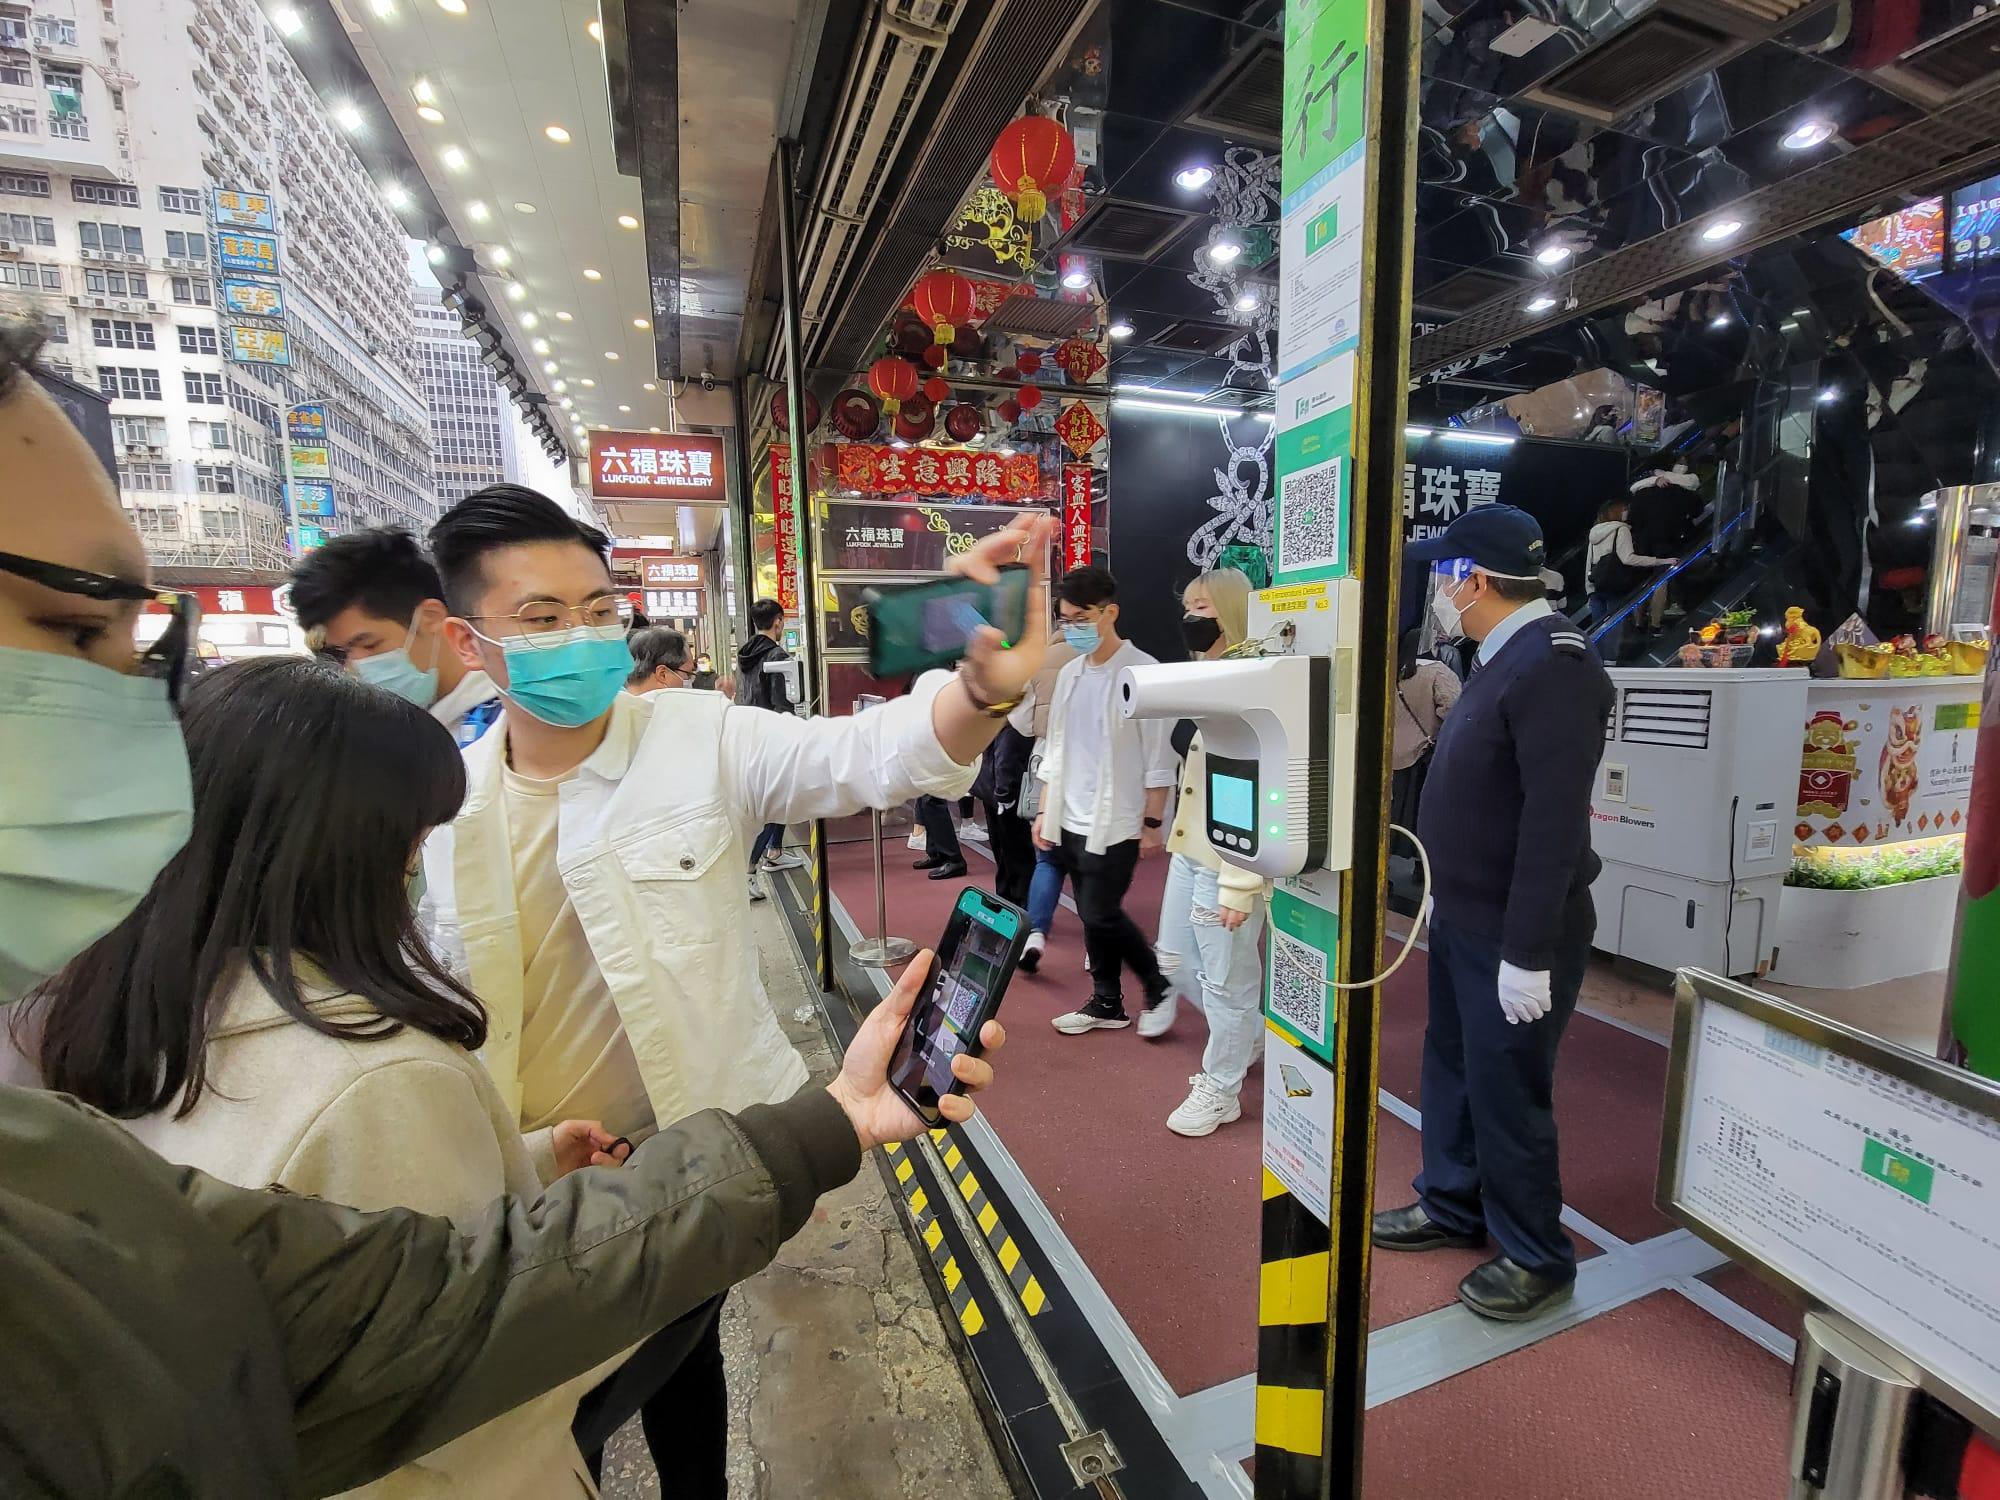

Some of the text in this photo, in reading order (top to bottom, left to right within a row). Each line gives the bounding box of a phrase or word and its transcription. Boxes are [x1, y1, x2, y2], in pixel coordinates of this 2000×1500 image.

[600, 446, 713, 476] 六福珠寶
[879, 453, 1004, 487] 生意興隆
[602, 474, 713, 486] LUKFOOK JEWELLERY
[845, 526, 904, 543] 六福珠寶
[1620, 815, 1655, 829] Blowers
